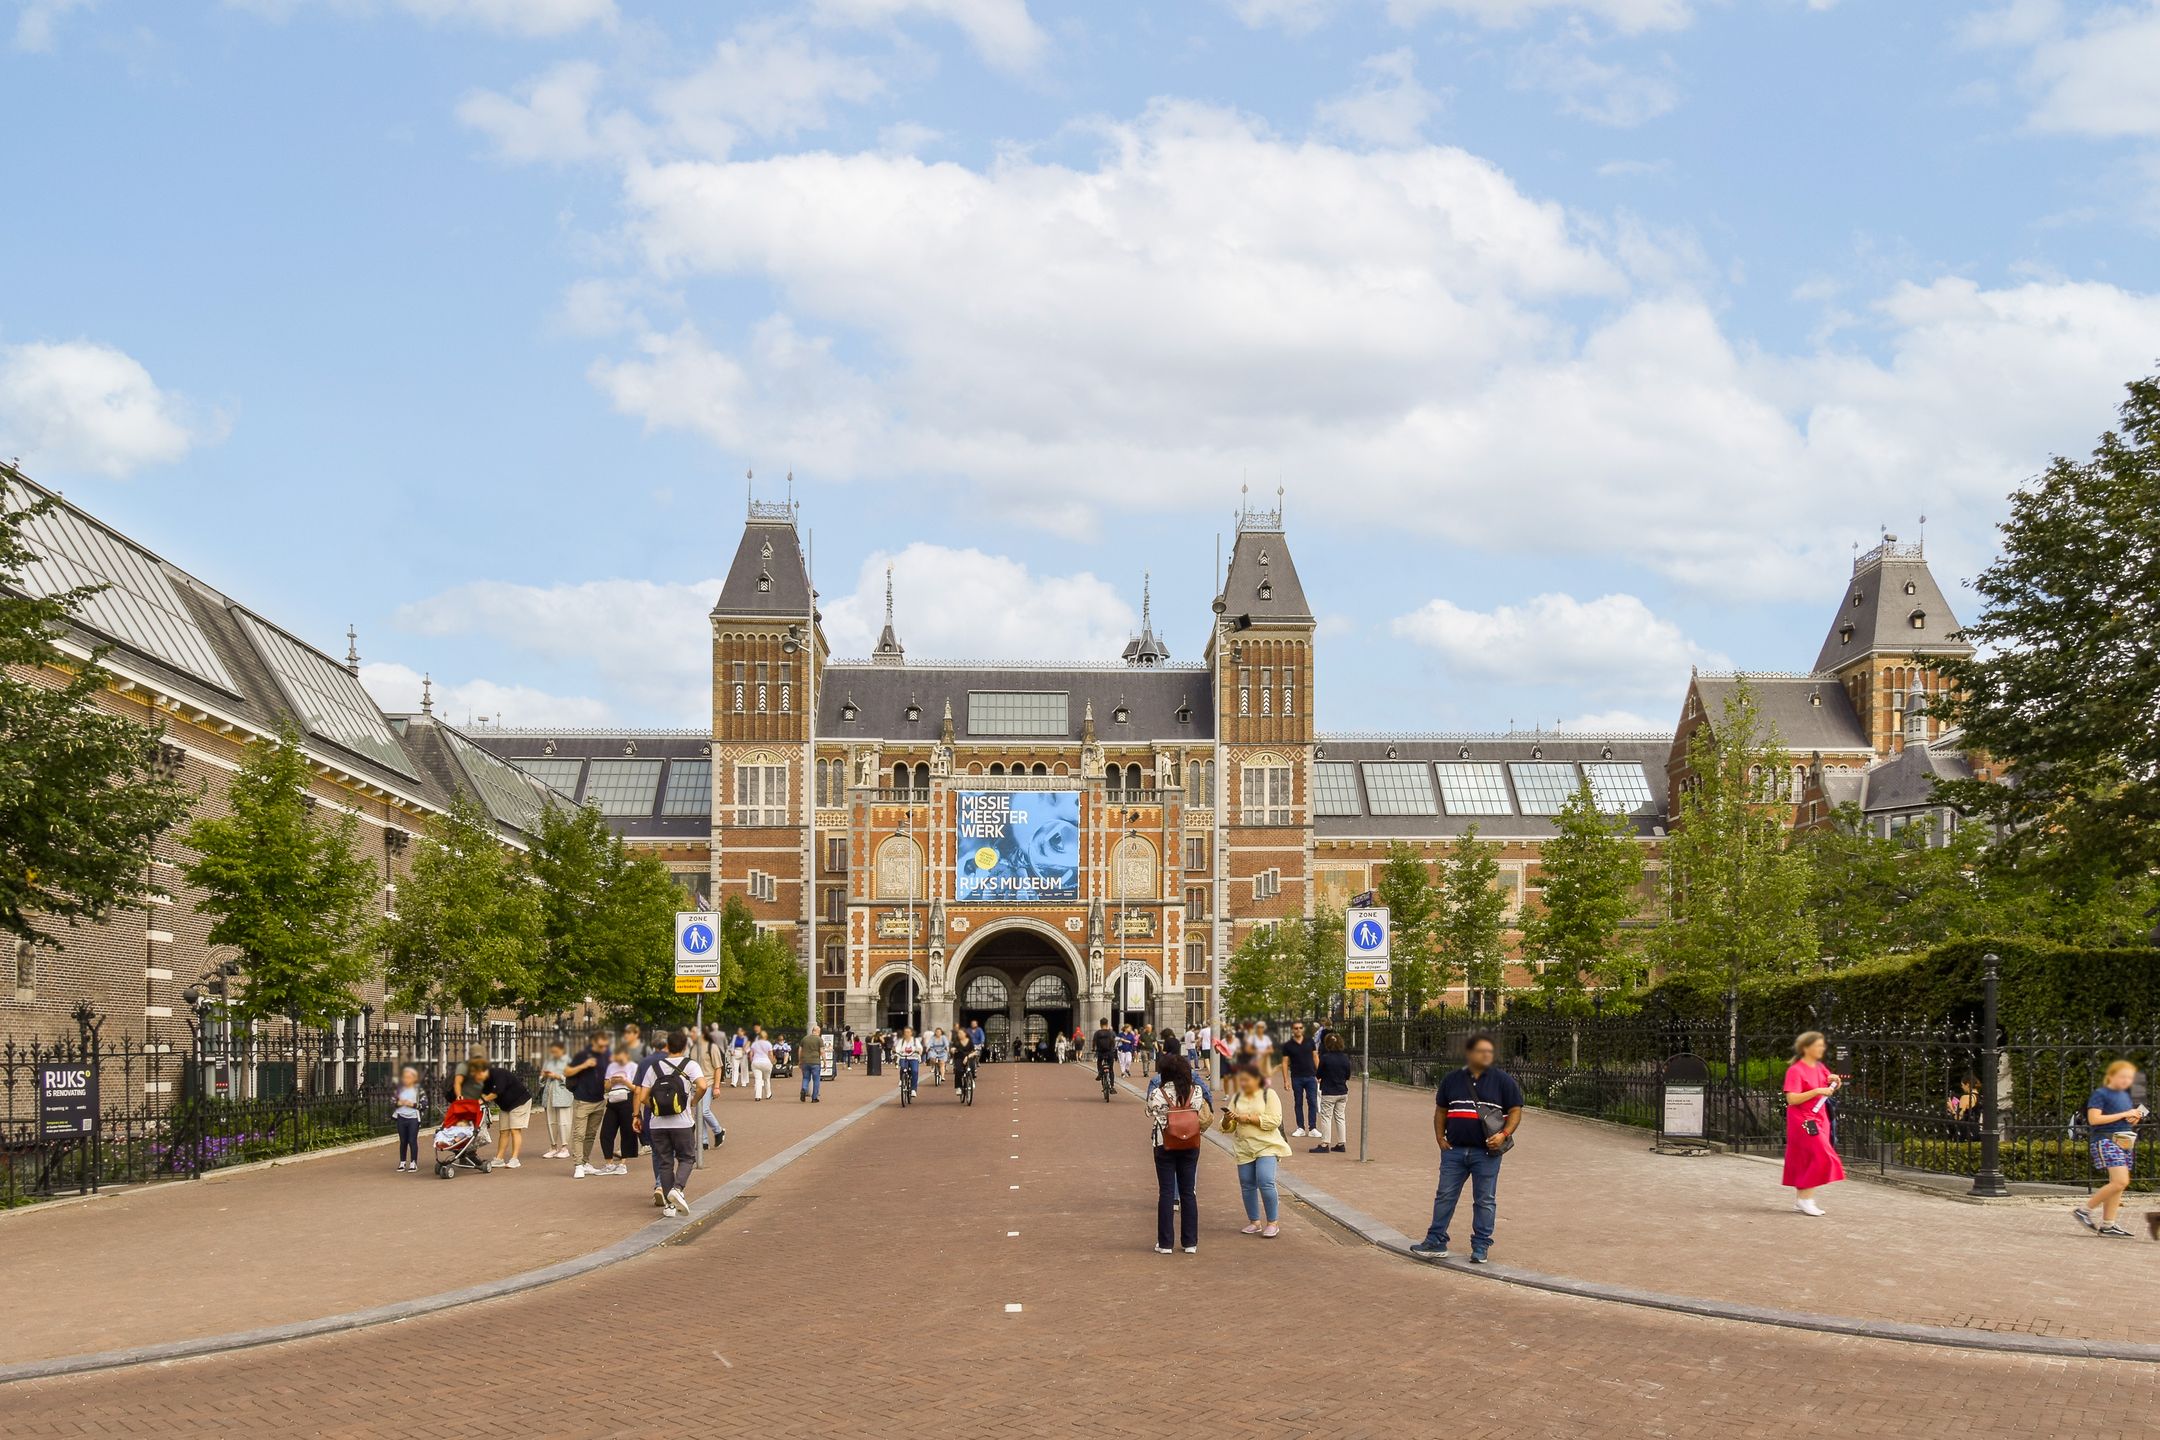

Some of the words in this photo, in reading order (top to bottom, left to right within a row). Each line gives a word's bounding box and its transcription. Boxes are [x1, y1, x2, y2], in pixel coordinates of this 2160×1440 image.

[961, 796, 1010, 810] MISSIE
[961, 810, 1028, 824] MEESTER
[961, 824, 1005, 838] WERK
[960, 877, 998, 890] RIJKS
[1000, 877, 1062, 890] MUSEUM
